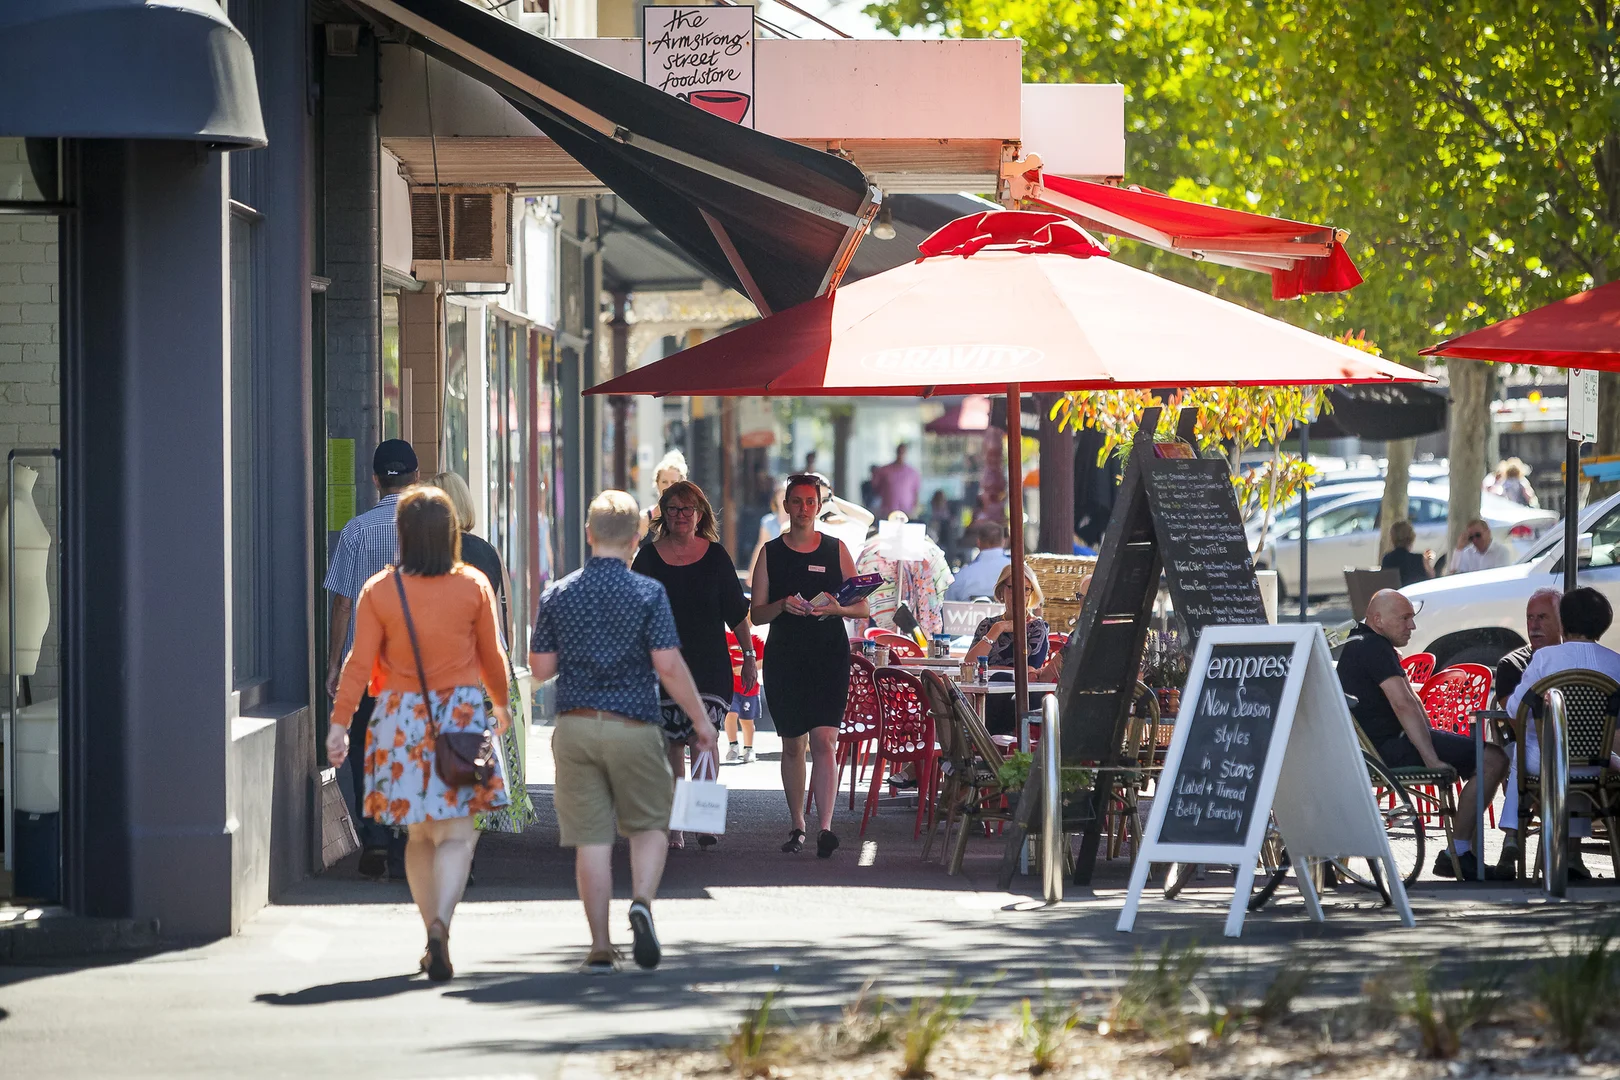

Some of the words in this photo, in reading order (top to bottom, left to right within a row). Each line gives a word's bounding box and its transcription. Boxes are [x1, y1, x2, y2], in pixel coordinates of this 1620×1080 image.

[663, 9, 709, 32] the
[652, 30, 750, 56] Armstrong
[663, 50, 720, 70] street
[659, 67, 741, 91] foodstore
[874, 345, 1032, 370] GRAVITY
[1207, 655, 1293, 687] empress
[1202, 689, 1230, 717] New
[1232, 687, 1271, 719] Season
[1214, 724, 1250, 752] styles
[1202, 753, 1211, 770] in
[1220, 759, 1255, 780] store
[1179, 775, 1206, 795] Label
[1216, 781, 1247, 801] Thread
[1206, 801, 1243, 833] Barclay
